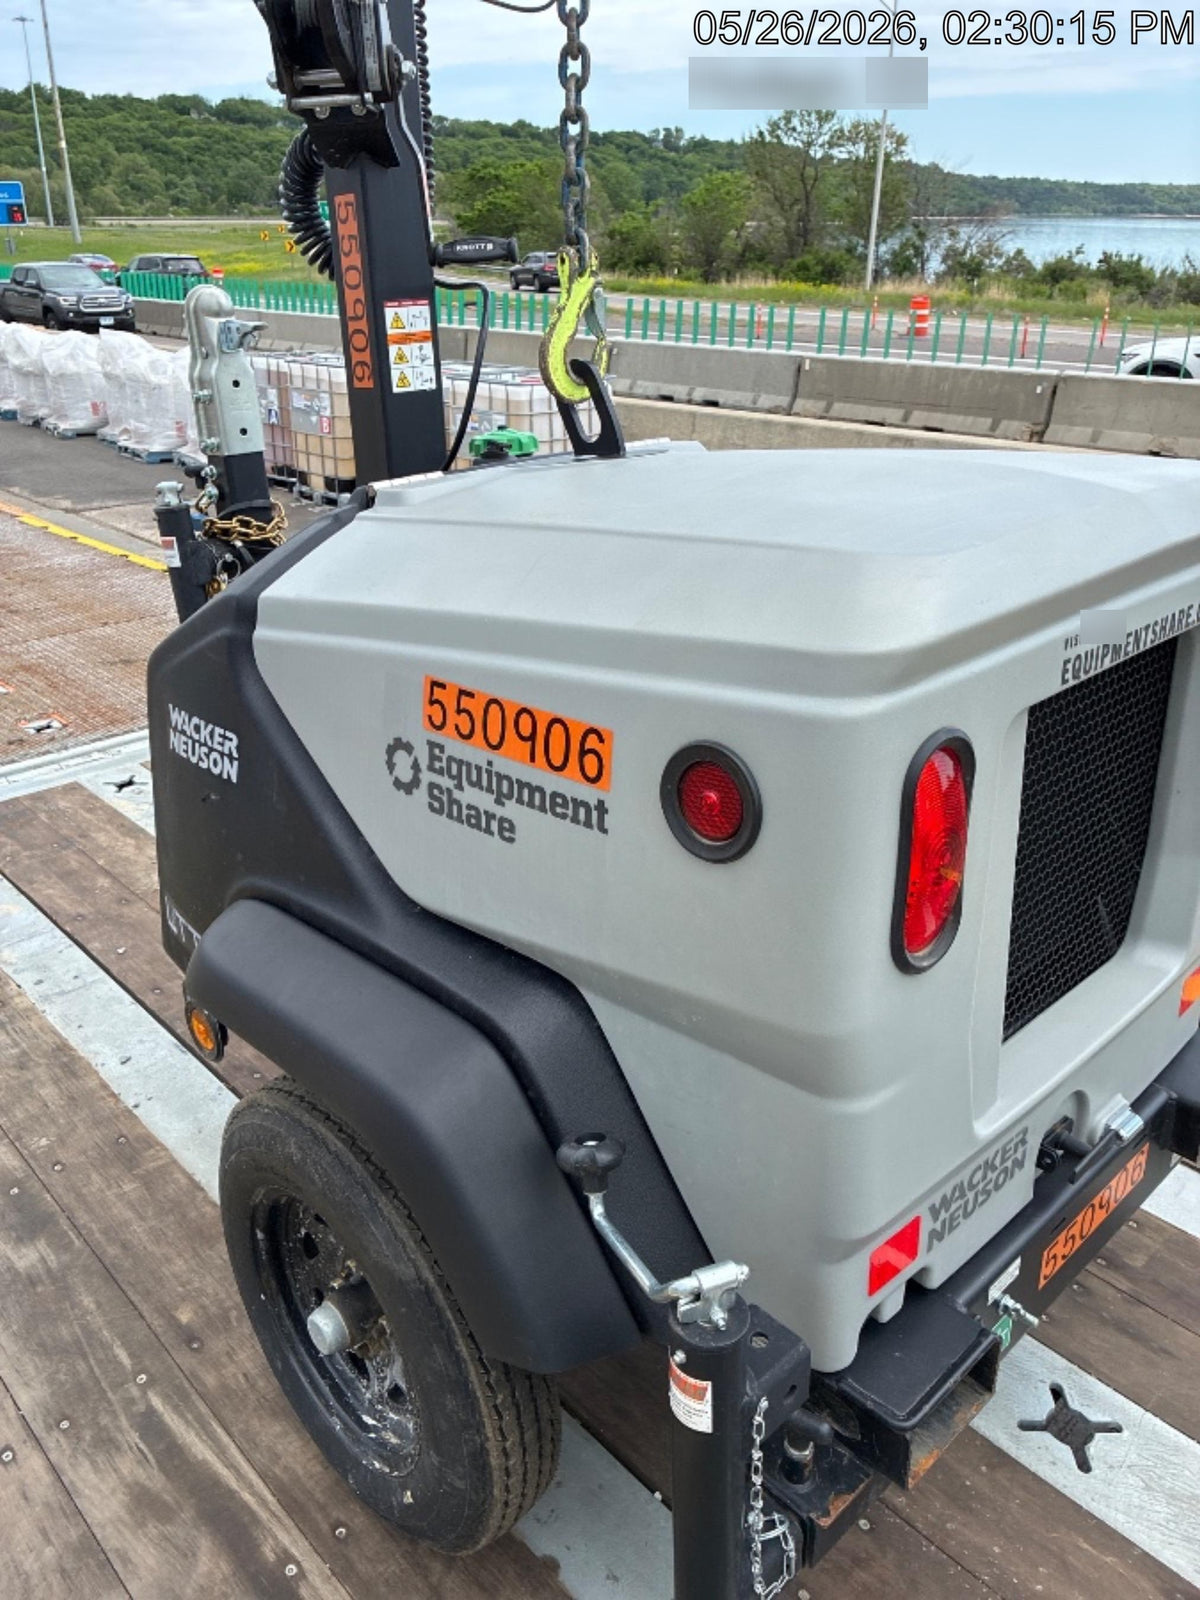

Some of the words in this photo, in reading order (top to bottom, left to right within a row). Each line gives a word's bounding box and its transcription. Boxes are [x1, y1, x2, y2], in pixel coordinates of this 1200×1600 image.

[336, 200, 371, 382] 550906
[168, 703, 239, 758] WACKER
[169, 728, 239, 784] NEUSON
[427, 680, 605, 785] 550906
[426, 739, 609, 836] Equipment
[427, 781, 516, 844] Share
[926, 1148, 1028, 1254] NEUSON
[928, 1126, 1029, 1224] WACKER
[1041, 1149, 1146, 1281] 550906
